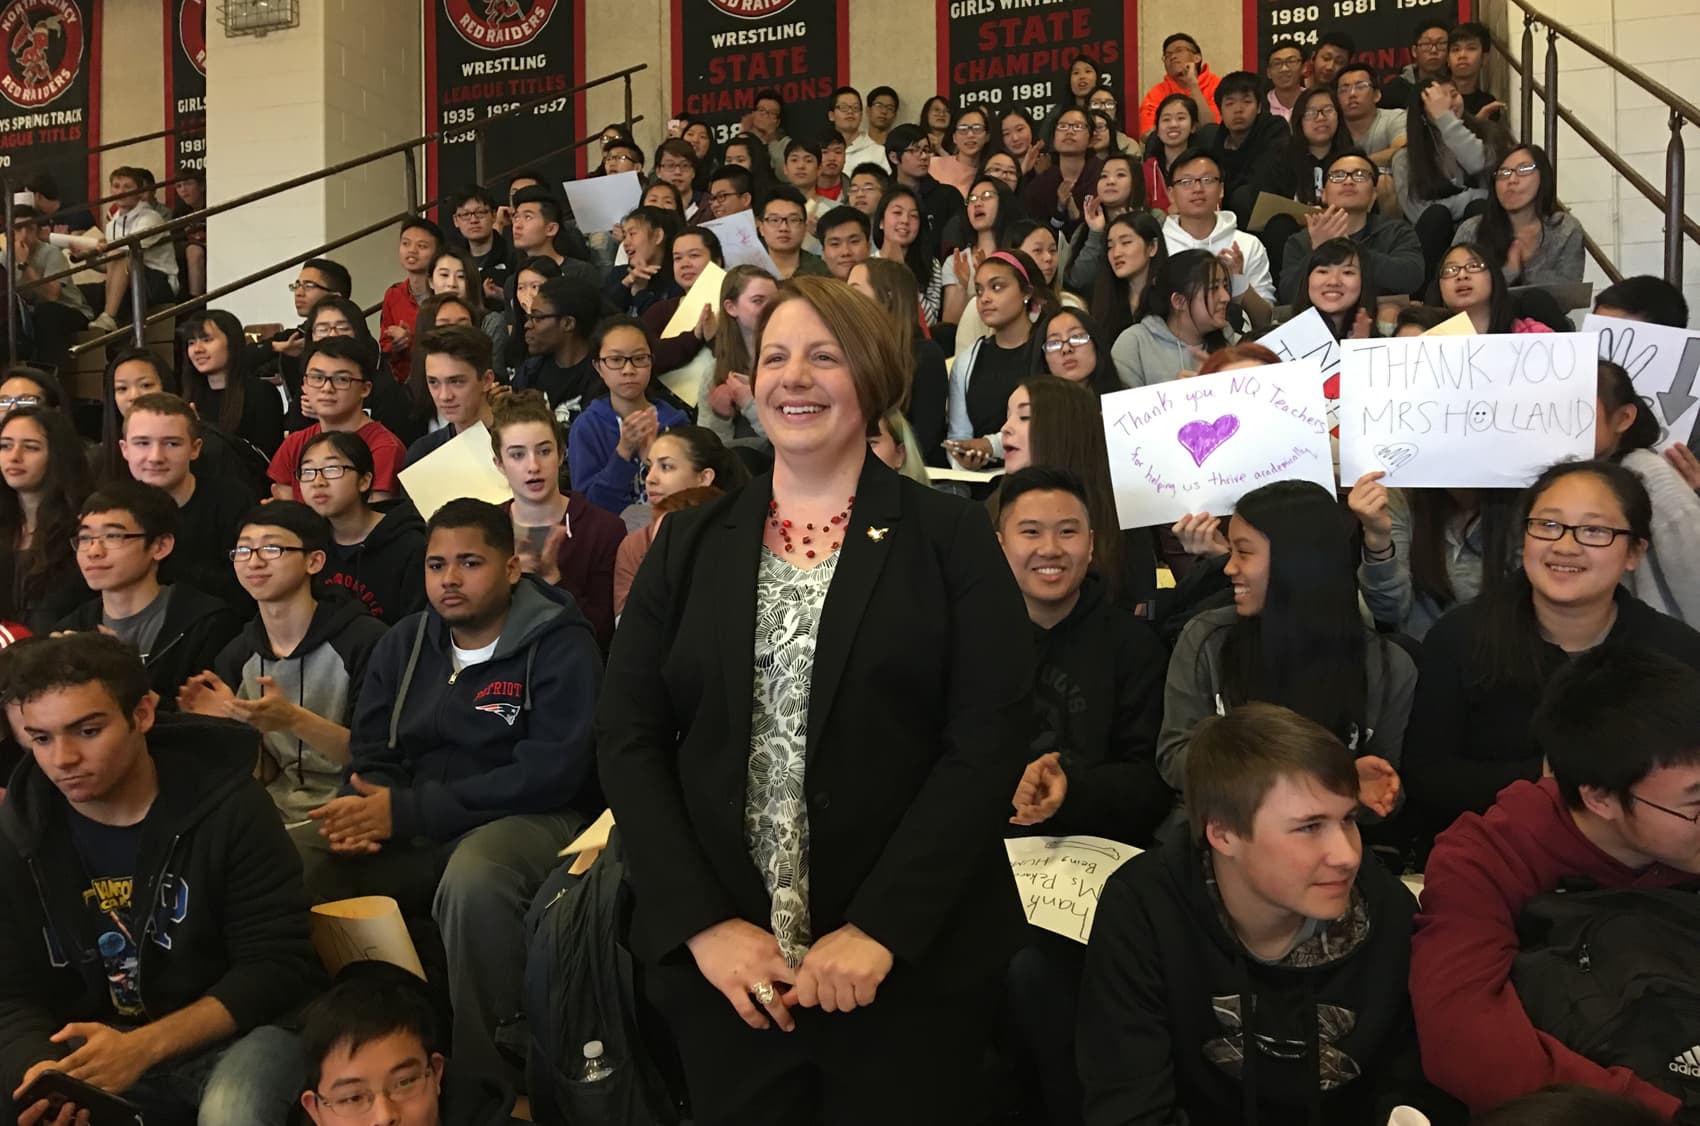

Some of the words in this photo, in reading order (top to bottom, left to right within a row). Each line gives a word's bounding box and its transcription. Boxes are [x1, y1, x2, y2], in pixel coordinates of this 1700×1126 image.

[459, 13, 485, 39] RED
[485, 6, 546, 42] RAIDERS
[950, 0, 996, 19] GIRLS
[1271, 5, 1320, 26] 1980
[1333, 0, 1376, 18] 1981
[711, 21, 807, 49] WRESTLING
[978, 8, 1091, 52] STATE
[461, 54, 547, 77] WRESTLING
[708, 46, 808, 85] STATE
[953, 40, 1119, 85] CHAMPIONS
[1, 75, 22, 98] RED
[22, 67, 71, 101] RAIDERS
[508, 75, 566, 95] TITLES
[687, 76, 833, 115] CHAMONS
[1012, 81, 1052, 100] 1981
[12, 112, 50, 131] SPRING
[51, 107, 82, 125] TRACK
[443, 107, 476, 125] 1935
[1353, 339, 1492, 389] THANK
[1508, 338, 1577, 387] YOU
[1113, 391, 1175, 436] Thank
[1186, 385, 1216, 413] you
[1230, 376, 1261, 398] NQ
[1269, 383, 1329, 435] Teachers
[1363, 399, 1439, 436] MRS
[1445, 398, 1595, 439] HOLLAND
[1131, 446, 1145, 468] for
[1144, 465, 1177, 498] helping
[1182, 482, 1200, 493] us
[1208, 472, 1247, 487] thrive
